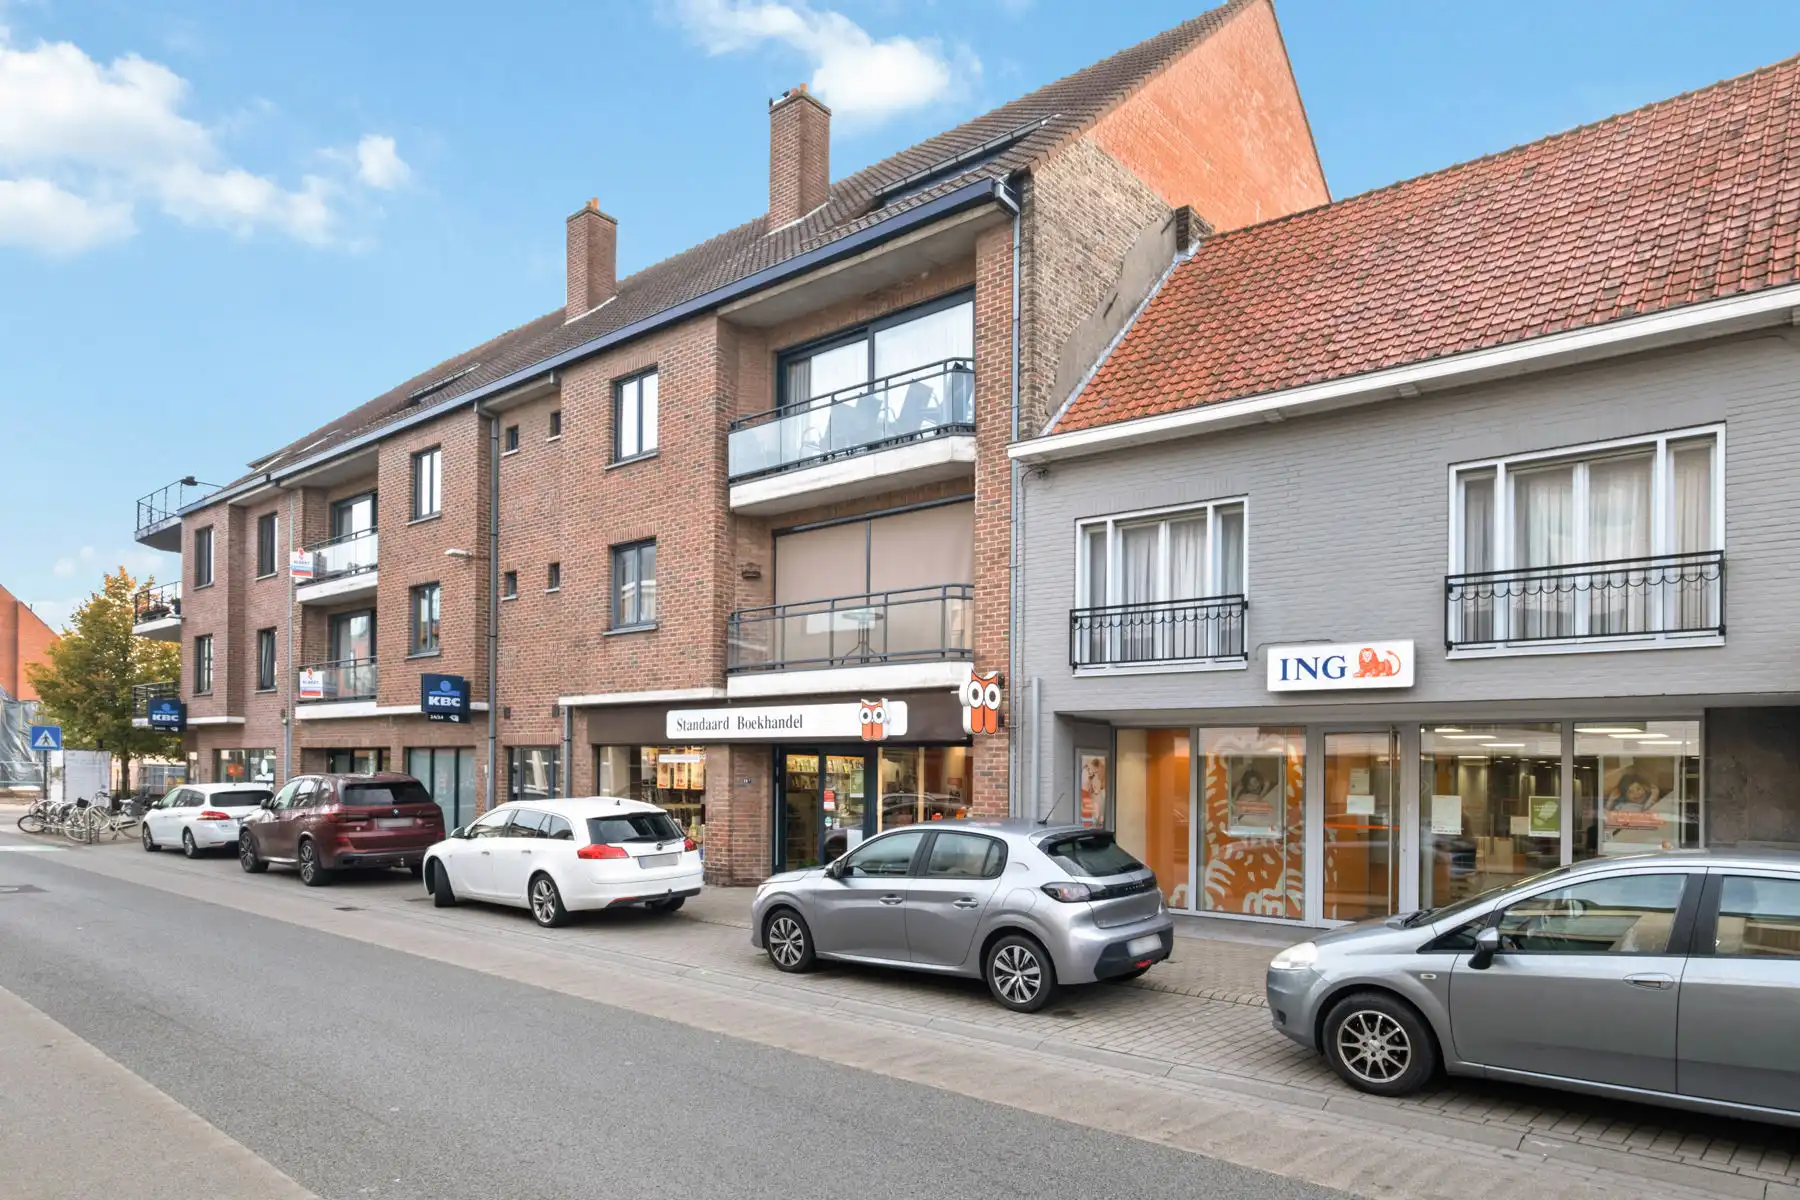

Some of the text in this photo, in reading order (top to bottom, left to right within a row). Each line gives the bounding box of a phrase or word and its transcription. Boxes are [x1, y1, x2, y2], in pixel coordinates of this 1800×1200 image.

[1280, 655, 1347, 681] ING
[428, 695, 461, 707] KBC
[152, 714, 179, 722] KBC
[676, 714, 803, 732] Standaard Boekhandel
